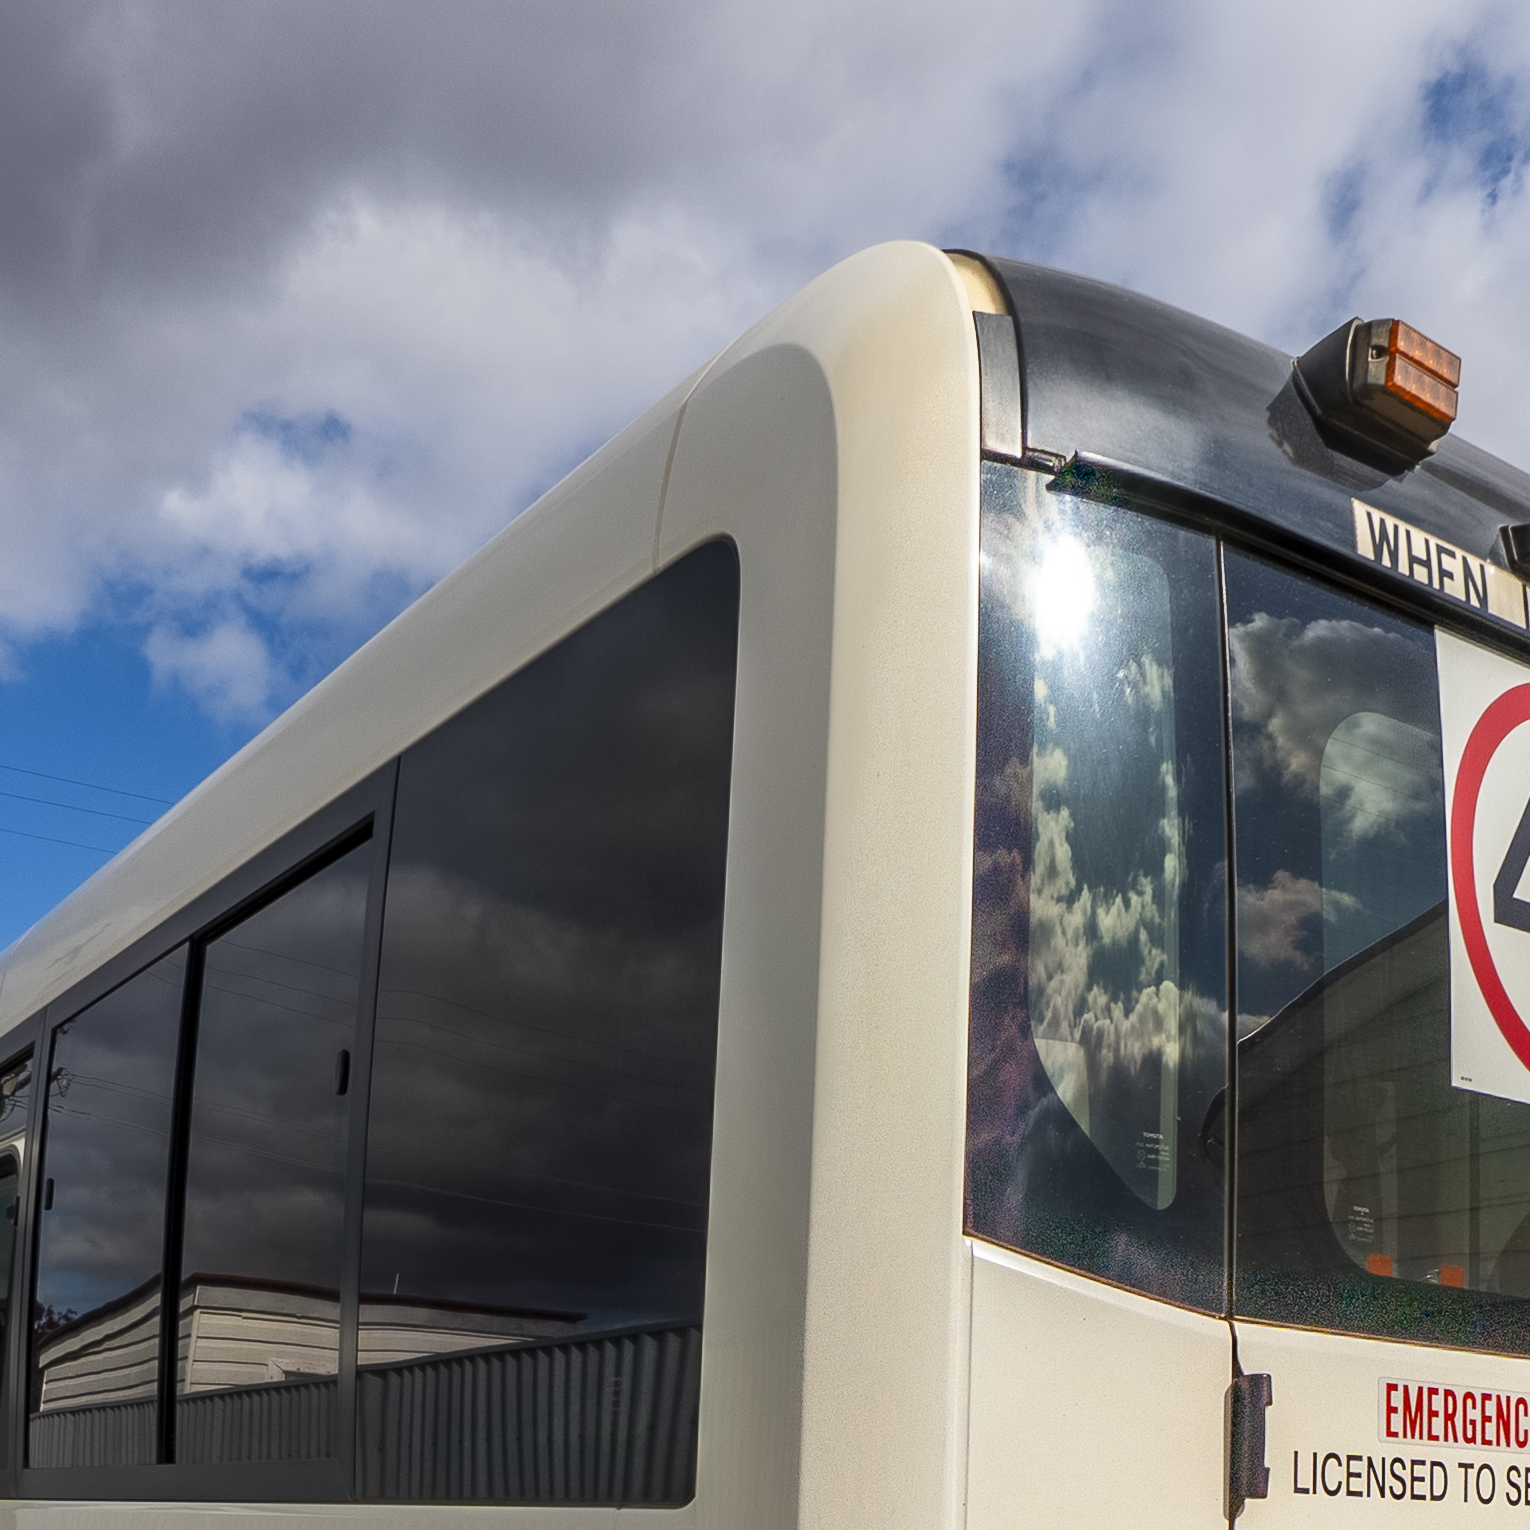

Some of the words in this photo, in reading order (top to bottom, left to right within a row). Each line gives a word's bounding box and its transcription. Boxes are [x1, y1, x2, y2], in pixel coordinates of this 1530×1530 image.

[1366, 510, 1488, 612] WHEN
[1293, 1450, 1449, 1502] LICENSED
[1457, 1462, 1496, 1502] TO
